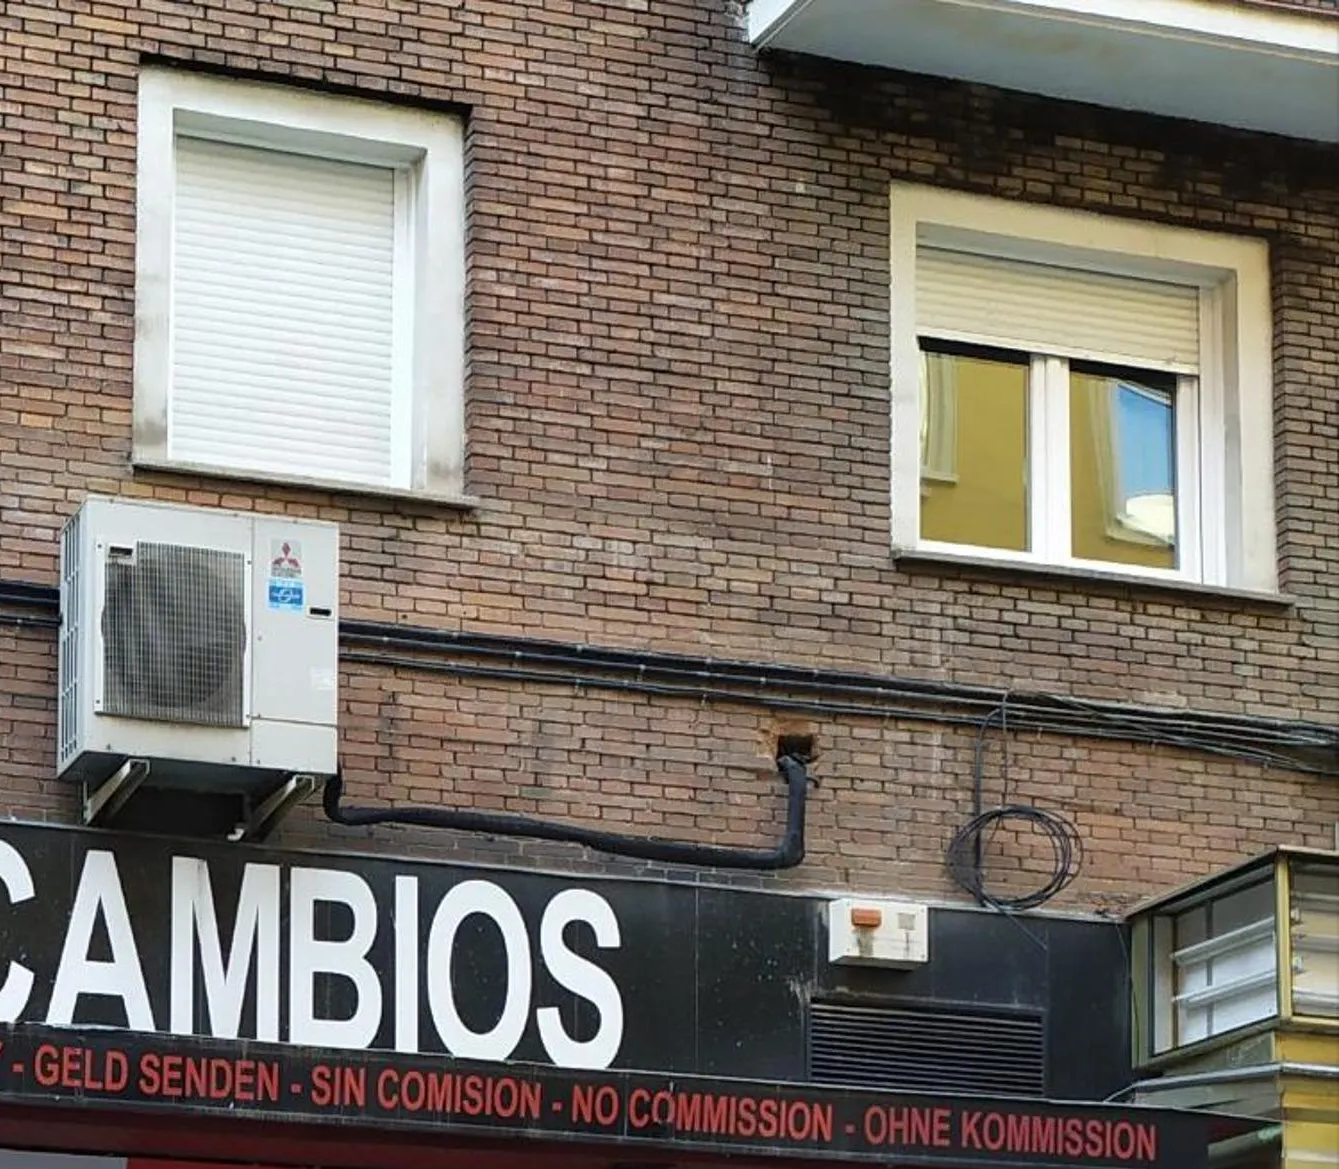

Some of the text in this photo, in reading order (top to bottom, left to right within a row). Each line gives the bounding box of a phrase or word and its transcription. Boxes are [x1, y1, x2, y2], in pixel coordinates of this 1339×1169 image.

[34, 1043, 129, 1092] GELD
[139, 1052, 280, 1101] SENDEN
[311, 1065, 366, 1107] SIN
[377, 1069, 542, 1120] COMISION
[572, 1085, 619, 1126] NO
[629, 1088, 833, 1142] COMMISSION
[864, 1105, 952, 1147] OHNE
[962, 1110, 1157, 1161] KOMMISSION
